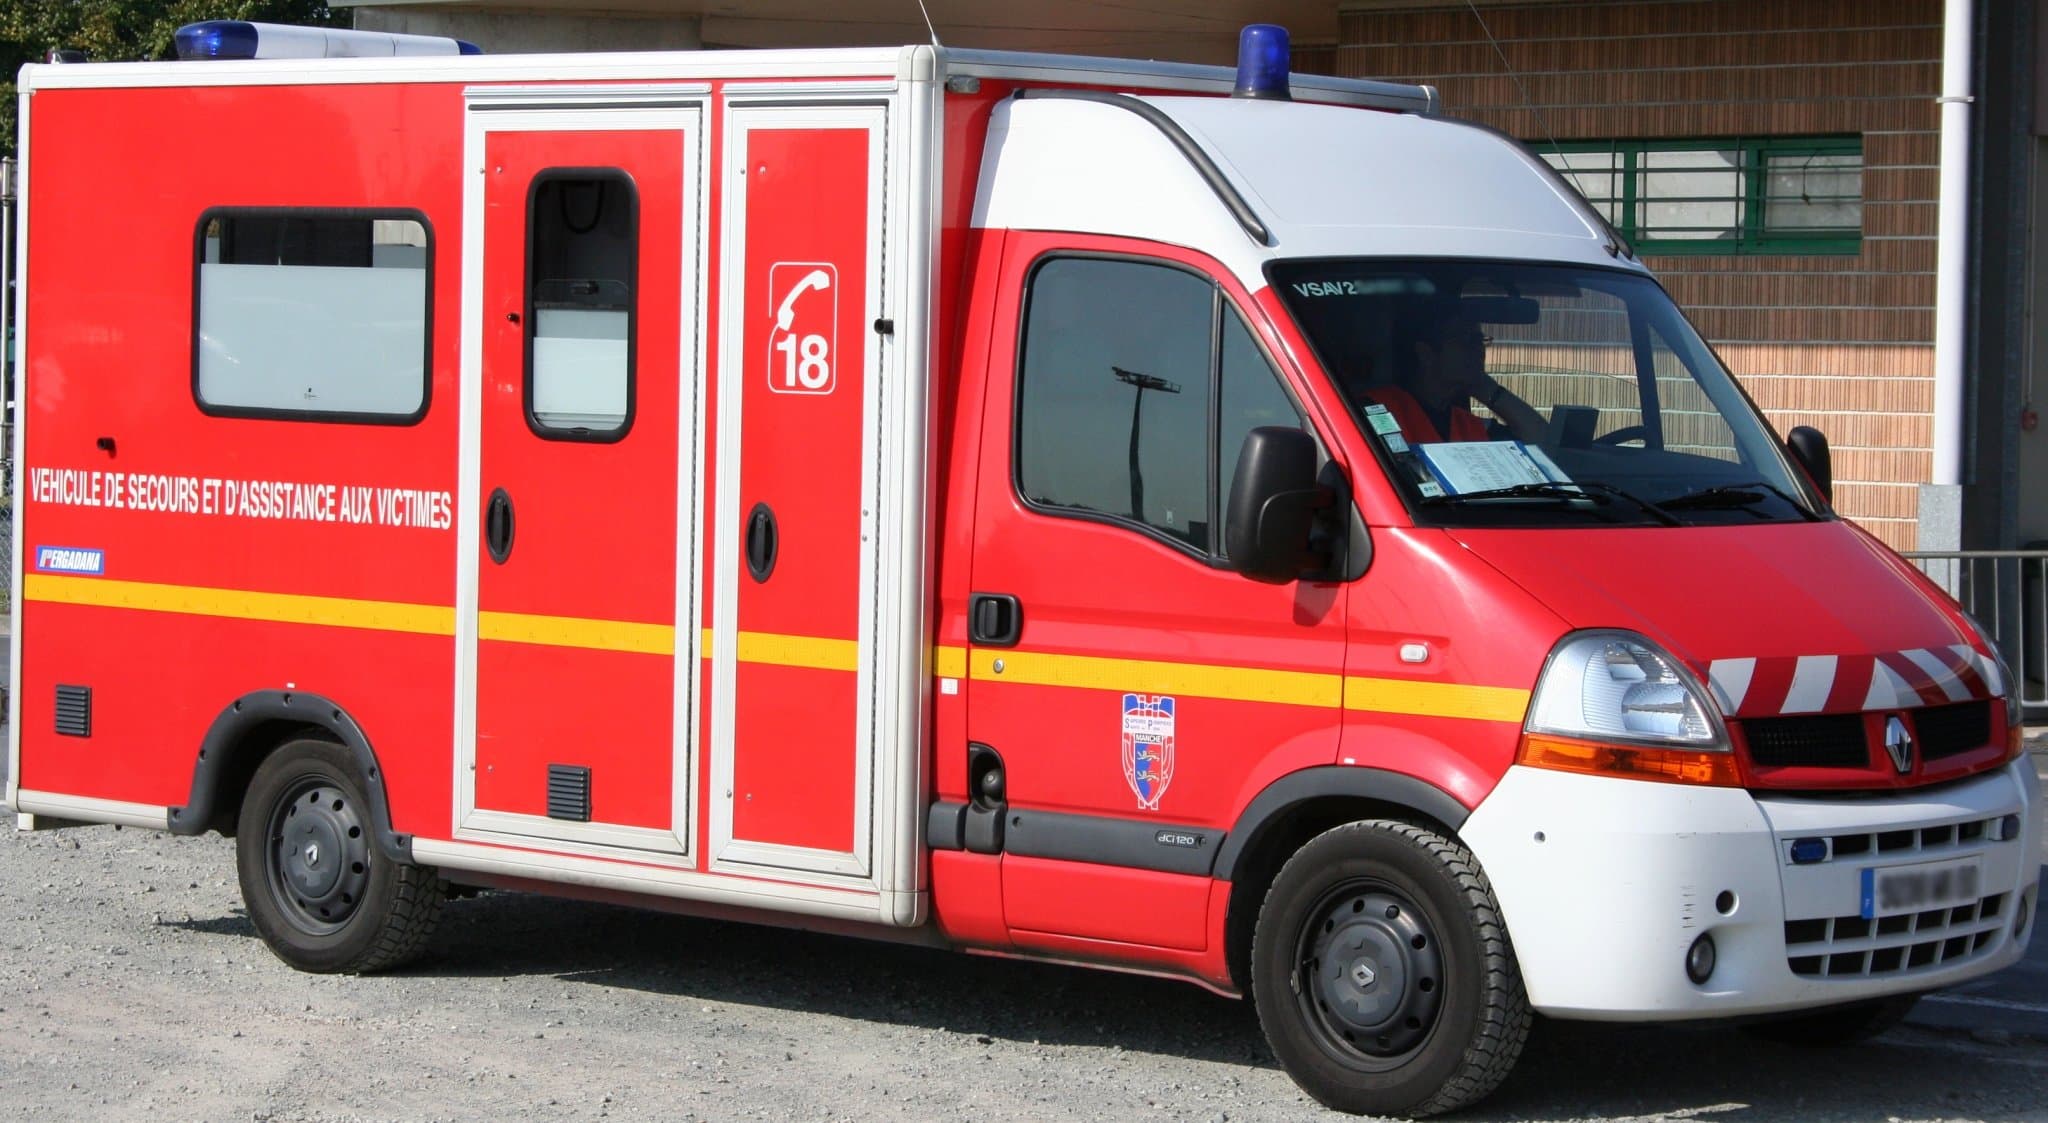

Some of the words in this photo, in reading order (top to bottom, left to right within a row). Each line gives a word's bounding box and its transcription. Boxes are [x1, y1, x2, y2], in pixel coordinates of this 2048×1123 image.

[776, 333, 830, 389] 18
[31, 467, 101, 507] VEHICULE
[104, 472, 125, 508] DE
[127, 473, 199, 514] SECOURS
[202, 478, 222, 515] ET
[224, 479, 336, 522] D'ASSISTANCE
[339, 485, 373, 524] AUX
[376, 487, 452, 530] VICTIMES
[1134, 733, 1161, 742] MANCHE
